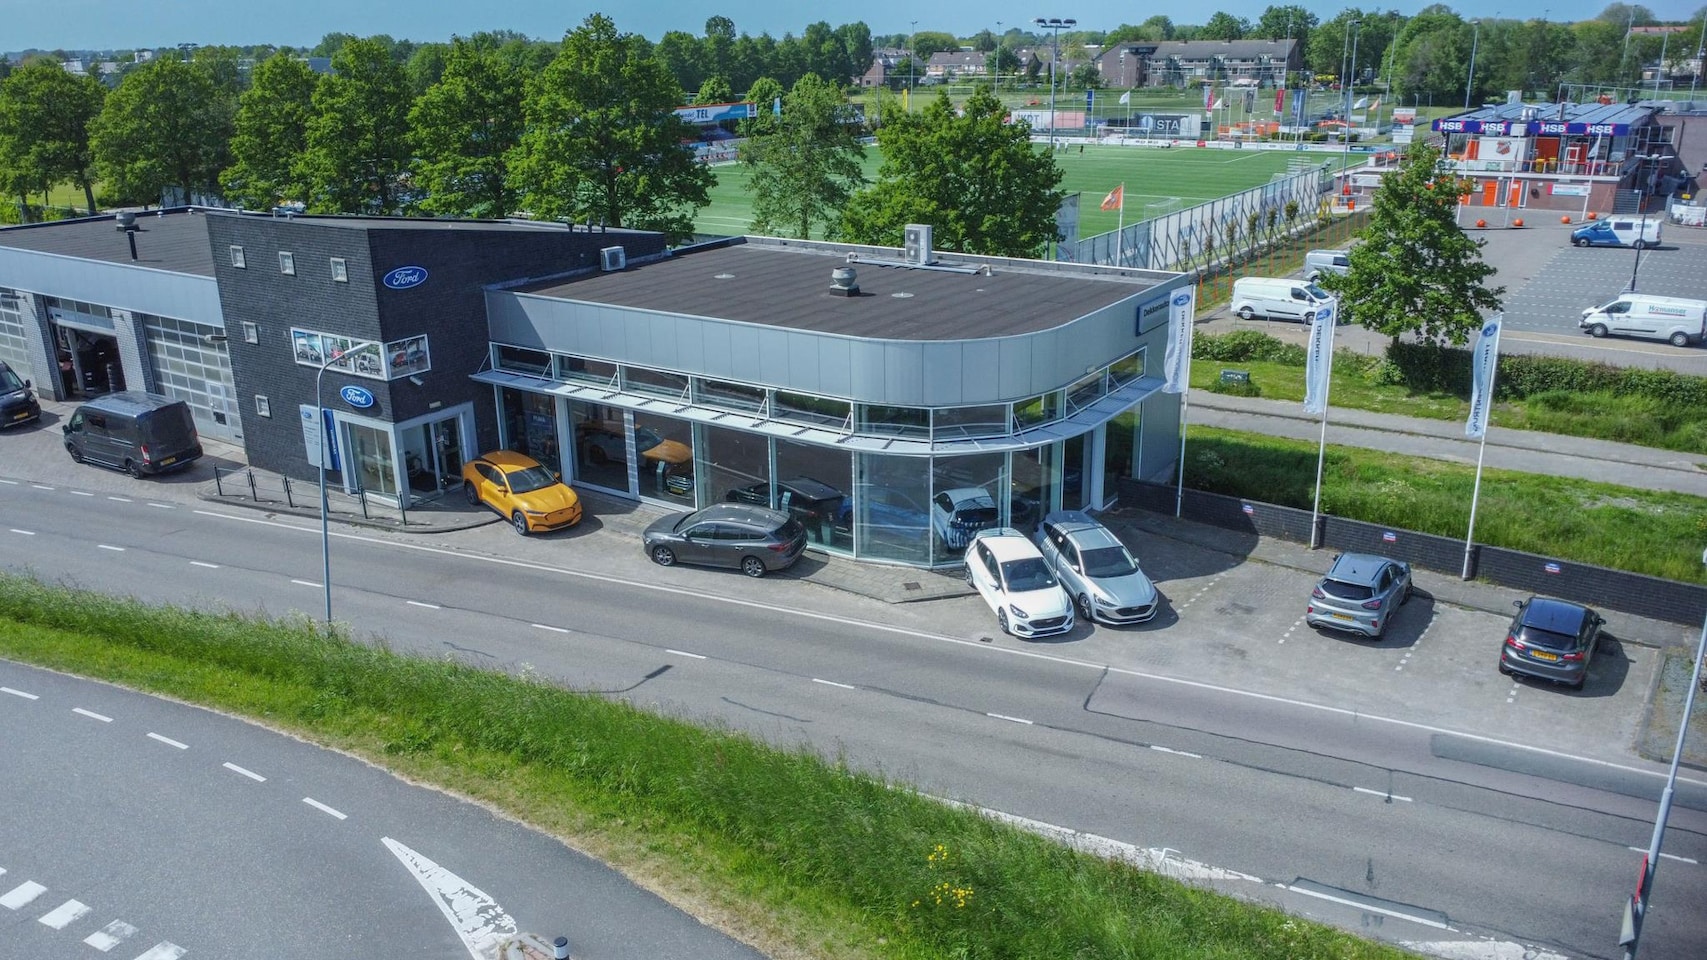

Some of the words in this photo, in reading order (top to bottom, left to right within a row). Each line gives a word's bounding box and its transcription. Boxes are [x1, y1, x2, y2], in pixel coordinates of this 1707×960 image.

[1440, 122, 1463, 131] HSB
[1481, 123, 1506, 132] HSB
[1541, 124, 1566, 133] HSB
[1587, 125, 1612, 134] HSB
[392, 270, 420, 286] Ford
[346, 388, 367, 404] Ford
